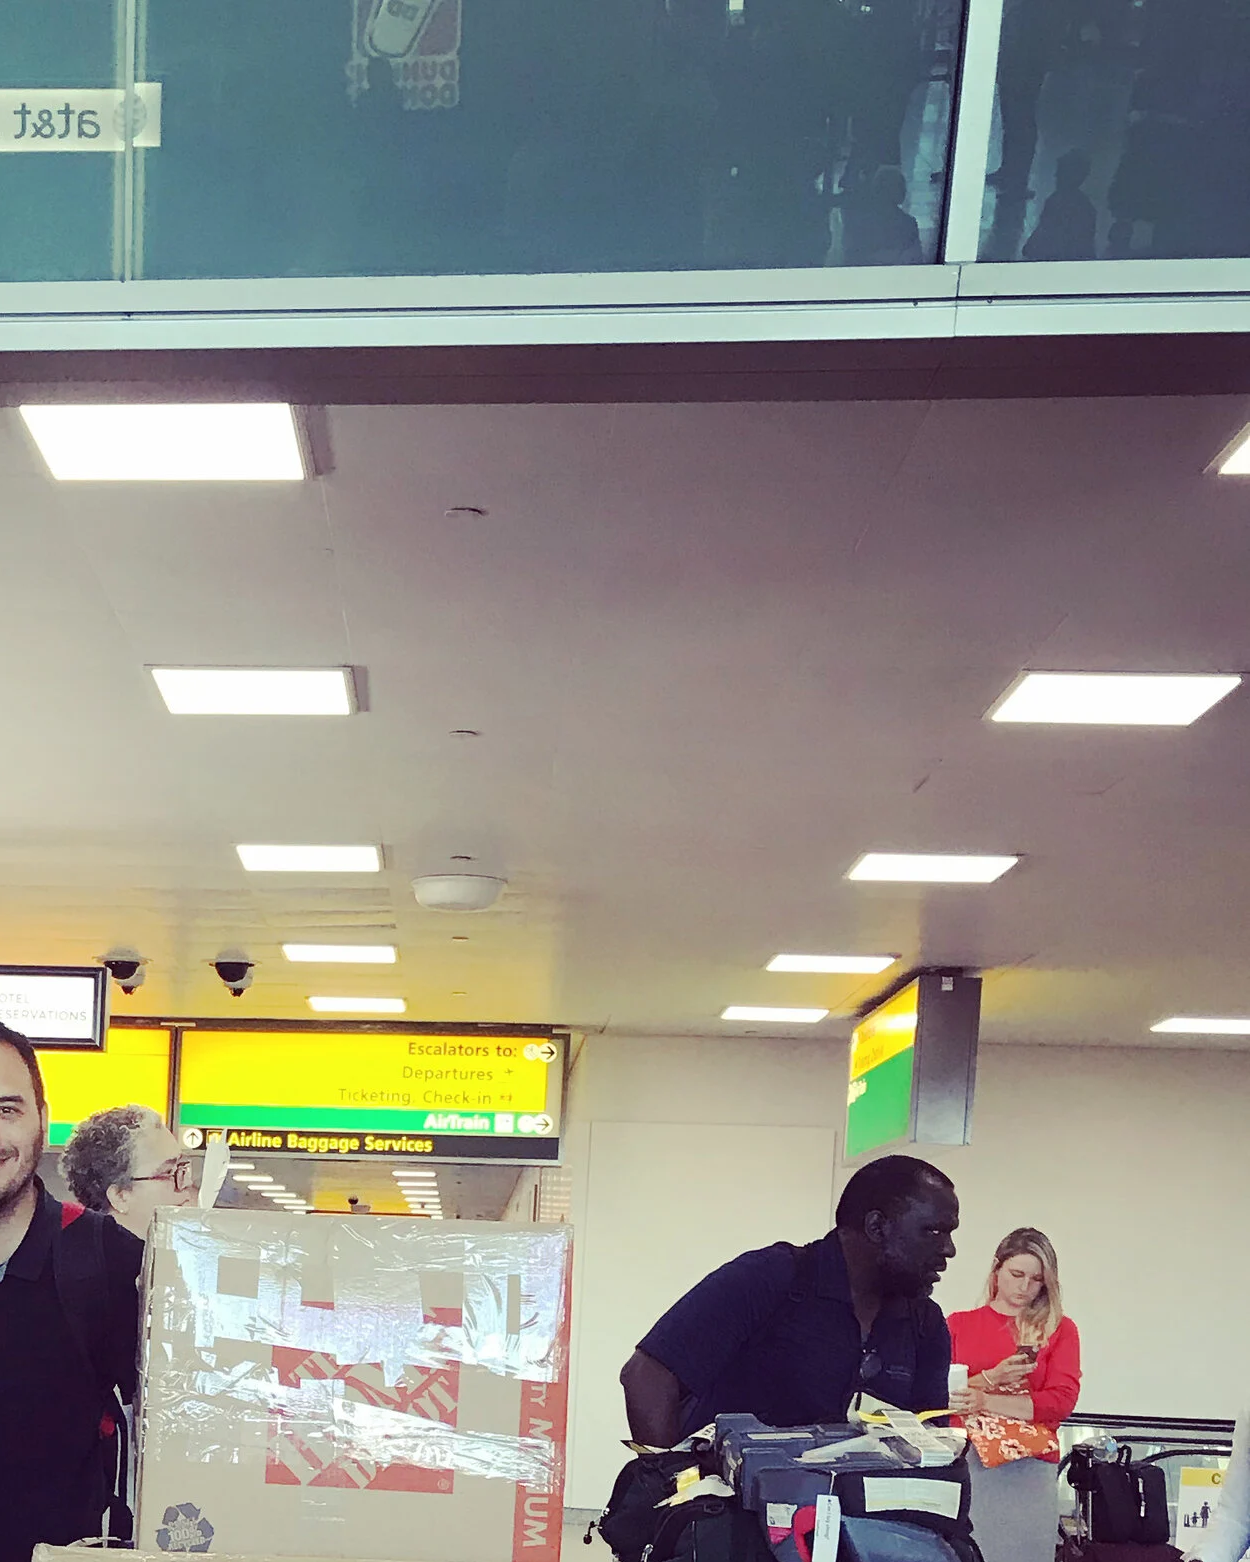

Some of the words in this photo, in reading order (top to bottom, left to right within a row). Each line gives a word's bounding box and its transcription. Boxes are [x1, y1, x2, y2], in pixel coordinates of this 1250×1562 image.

[408, 1042, 489, 1057] Escalators
[496, 1045, 517, 1057] to:
[402, 1066, 493, 1082] Departures
[423, 1090, 492, 1105] Check-in
[423, 1113, 490, 1130] AirTrain
[228, 1132, 282, 1148] Airline
[287, 1133, 360, 1154] Baggage
[364, 1135, 433, 1153] Services
